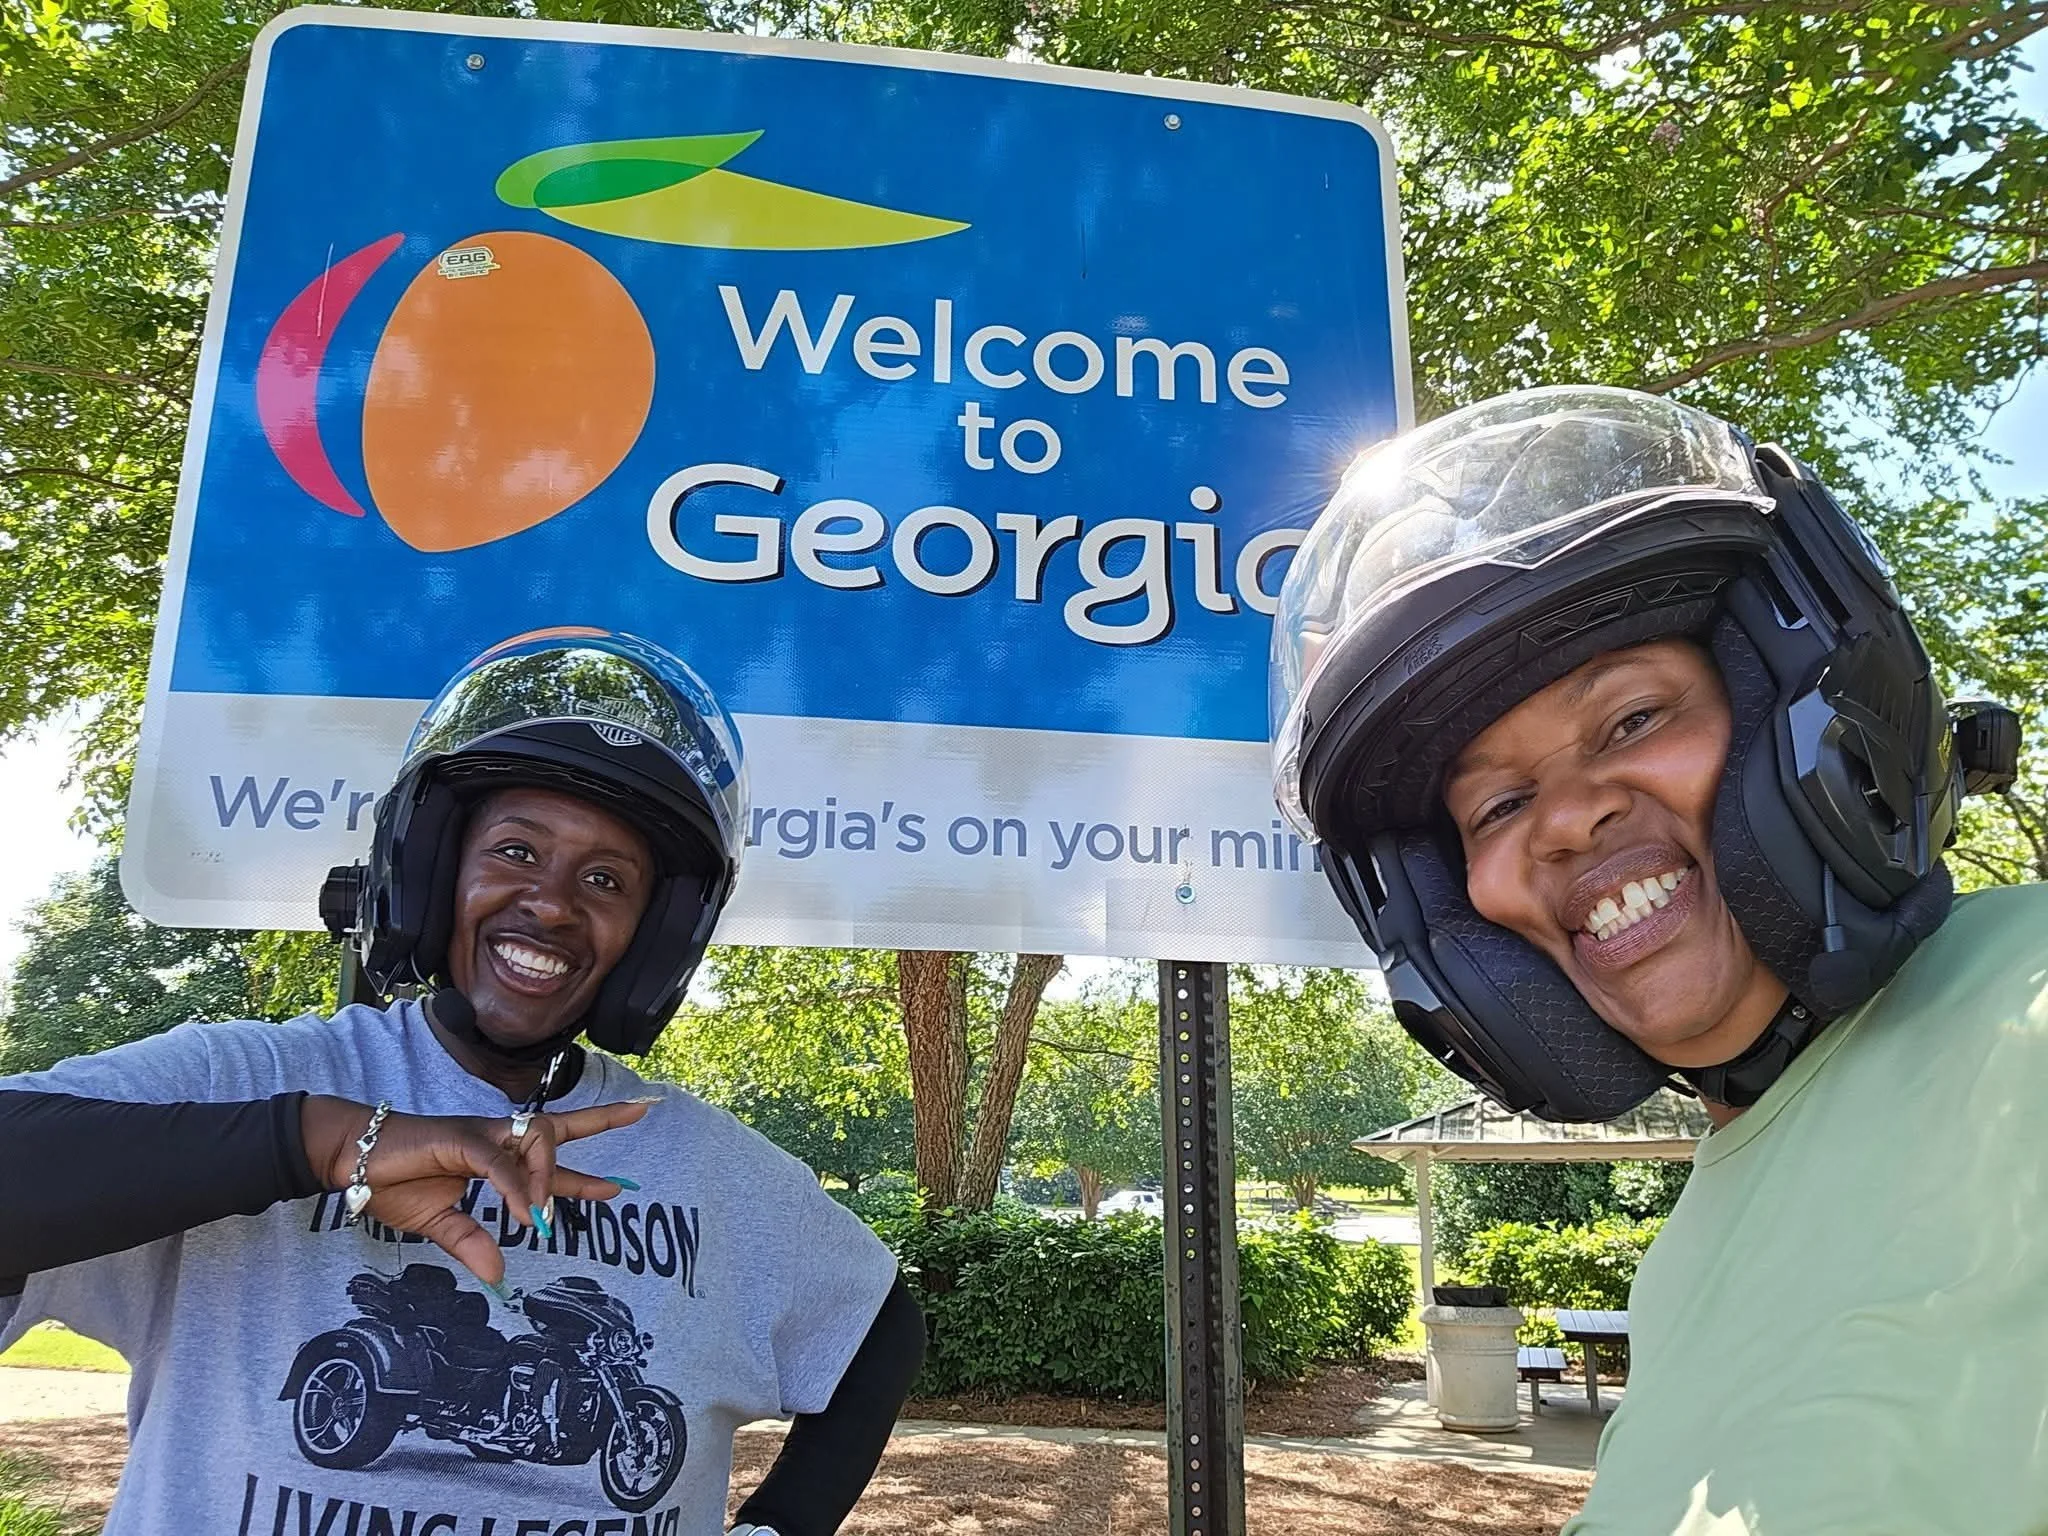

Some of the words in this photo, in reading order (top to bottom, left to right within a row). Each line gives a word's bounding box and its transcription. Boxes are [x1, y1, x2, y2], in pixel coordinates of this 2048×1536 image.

[718, 284, 1290, 408] Welcome
[957, 401, 1062, 474] to
[209, 775, 386, 832] We'r
[948, 814, 1028, 857] on
[1048, 820, 1190, 870] your
[1211, 819, 1322, 873] min
